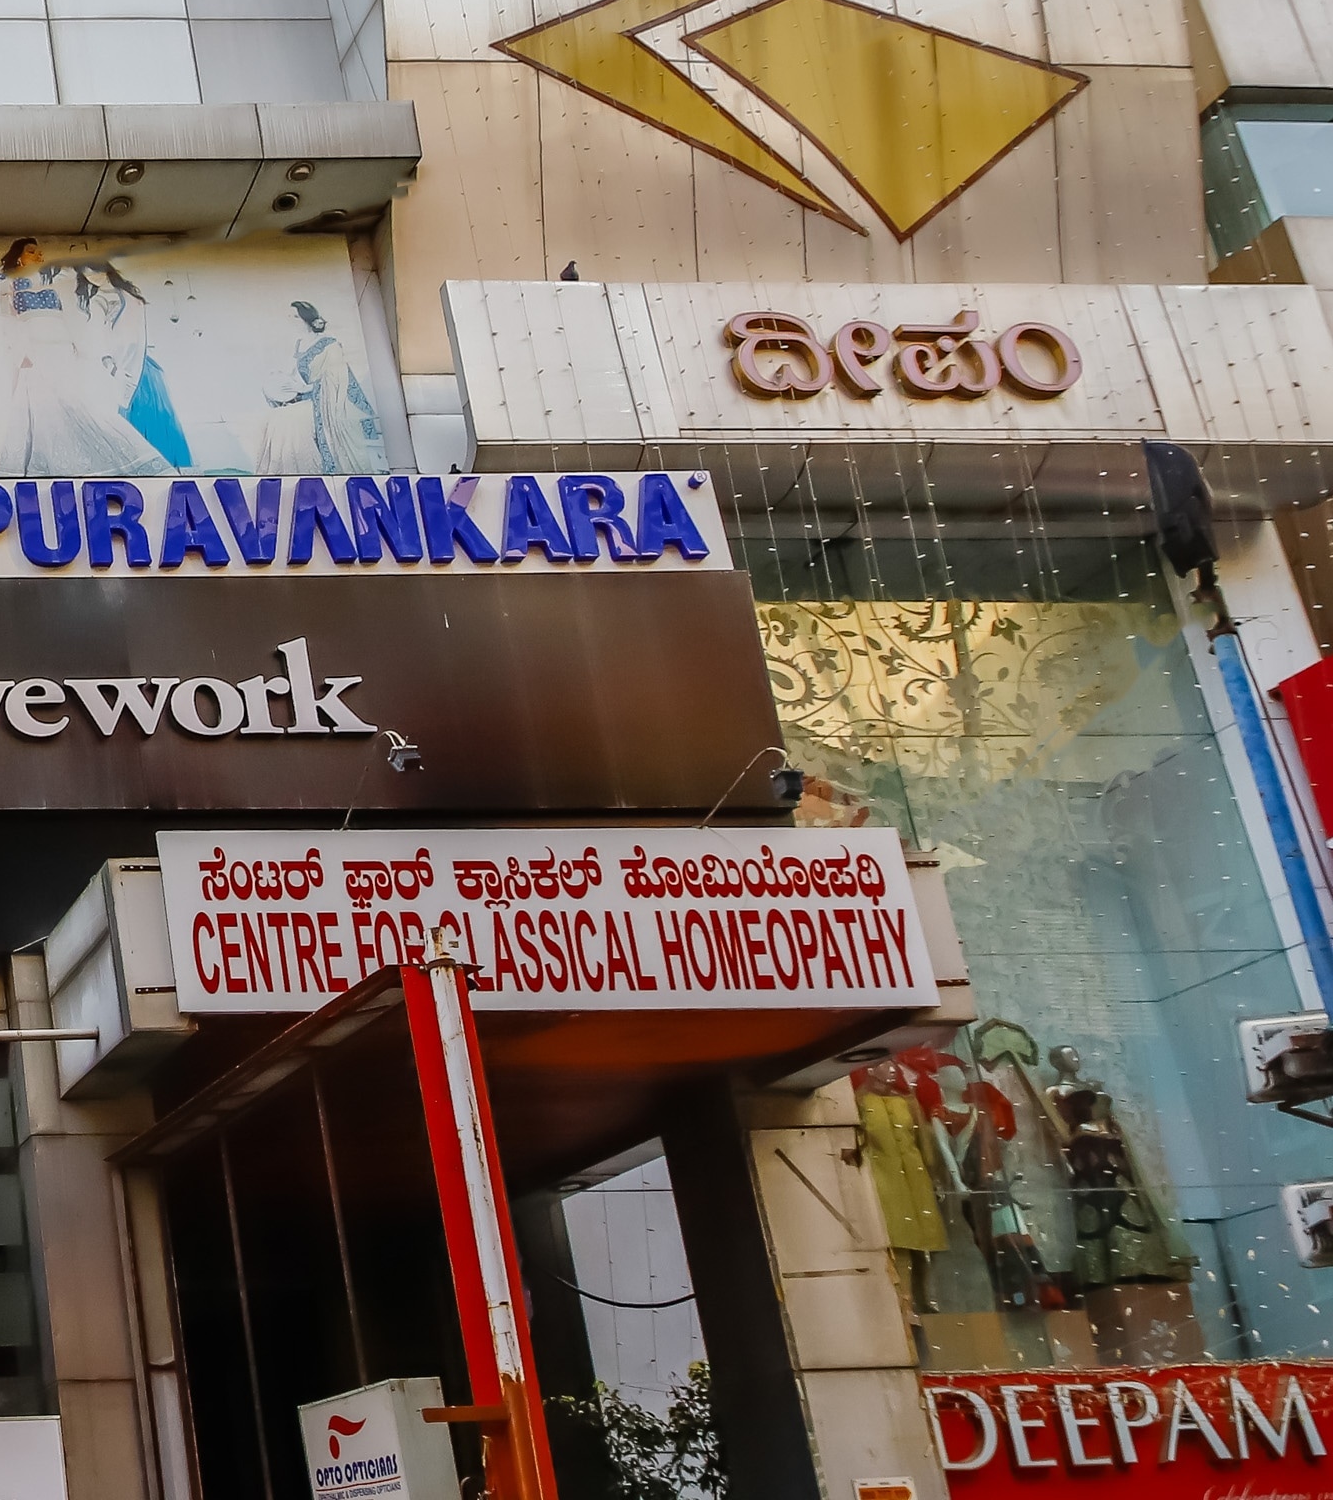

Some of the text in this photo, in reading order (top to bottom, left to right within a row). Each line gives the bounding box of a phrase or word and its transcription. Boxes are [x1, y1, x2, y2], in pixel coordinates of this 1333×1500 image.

[723, 309, 1083, 400] ದೀಪಂ
[198, 846, 324, 902] ಸೆಂಟರ್
[451, 845, 604, 910] ಕ್ಲಾಸಿಕಲ್
[191, 911, 349, 994] CENTRE
[659, 907, 916, 992] HOMEOPATHY
[925, 1374, 1328, 1471] DEEPAM
[316, 1453, 398, 1488] OPTO OPTICIANS
